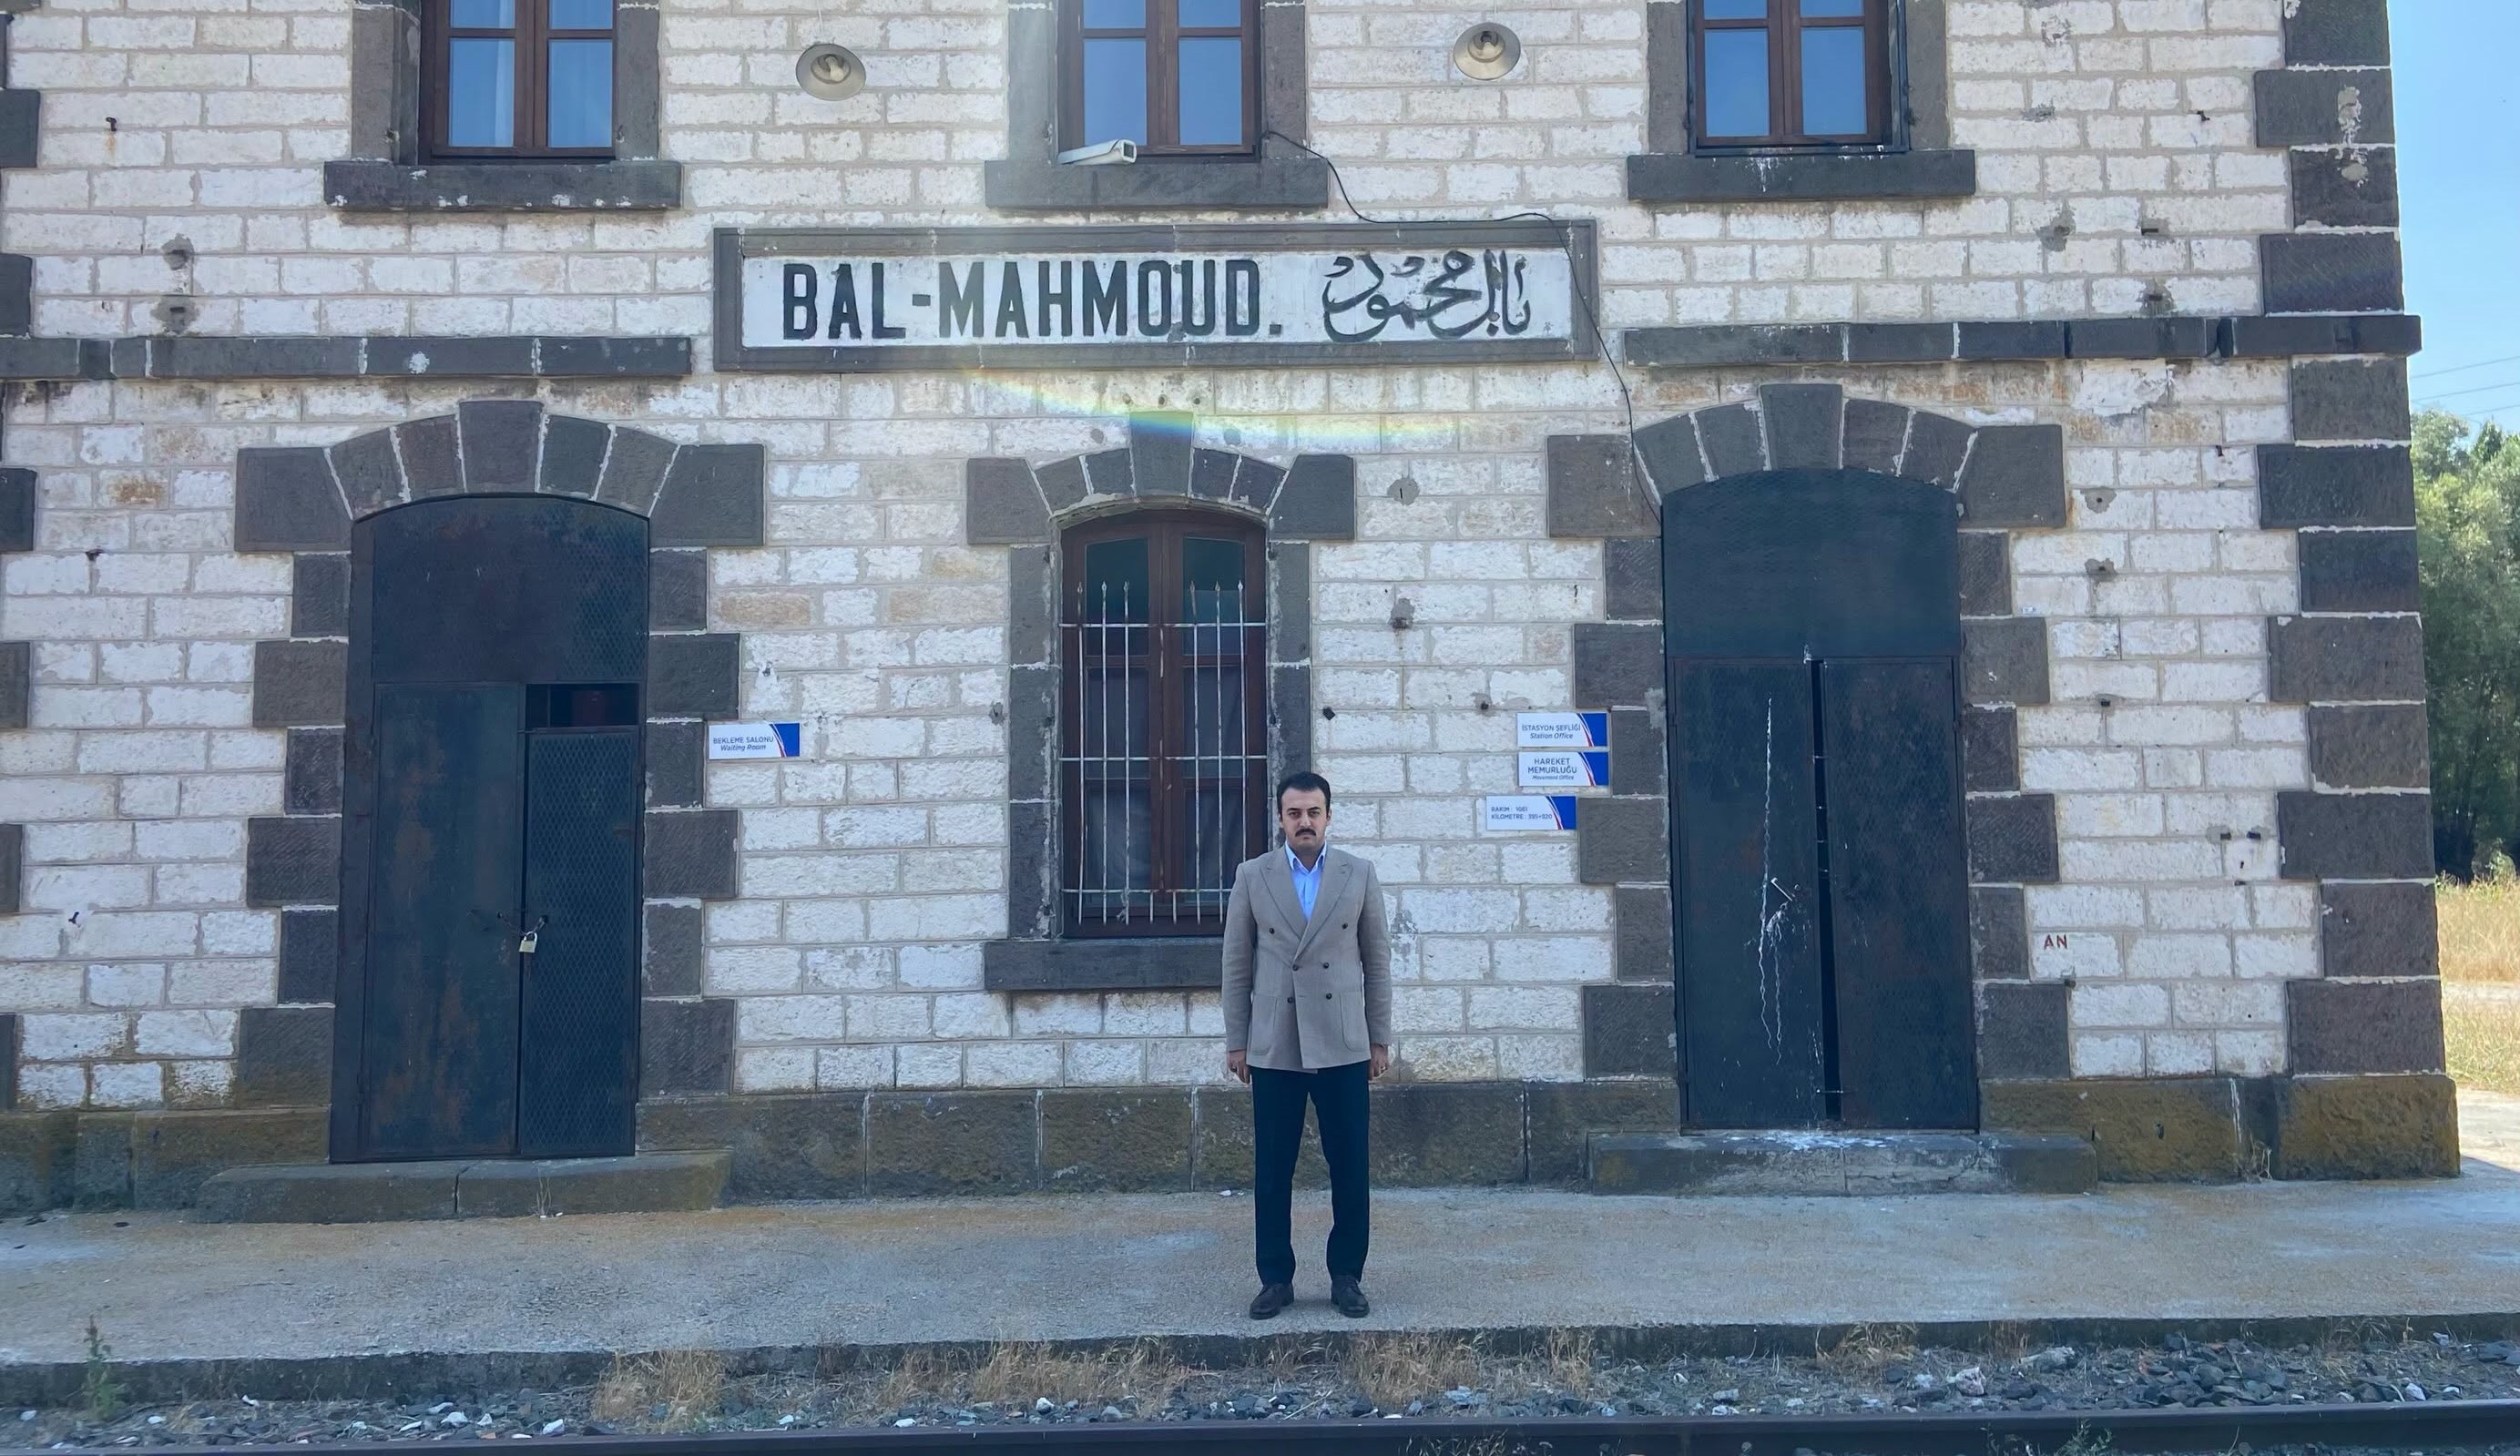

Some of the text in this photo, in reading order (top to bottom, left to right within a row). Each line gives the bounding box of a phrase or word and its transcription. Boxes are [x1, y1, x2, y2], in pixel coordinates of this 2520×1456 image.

[1556, 723, 1581, 732] ŞEFLİĞİ
[1527, 765, 1577, 774] MEMURLUĞU
[2044, 934, 2068, 950] AN
